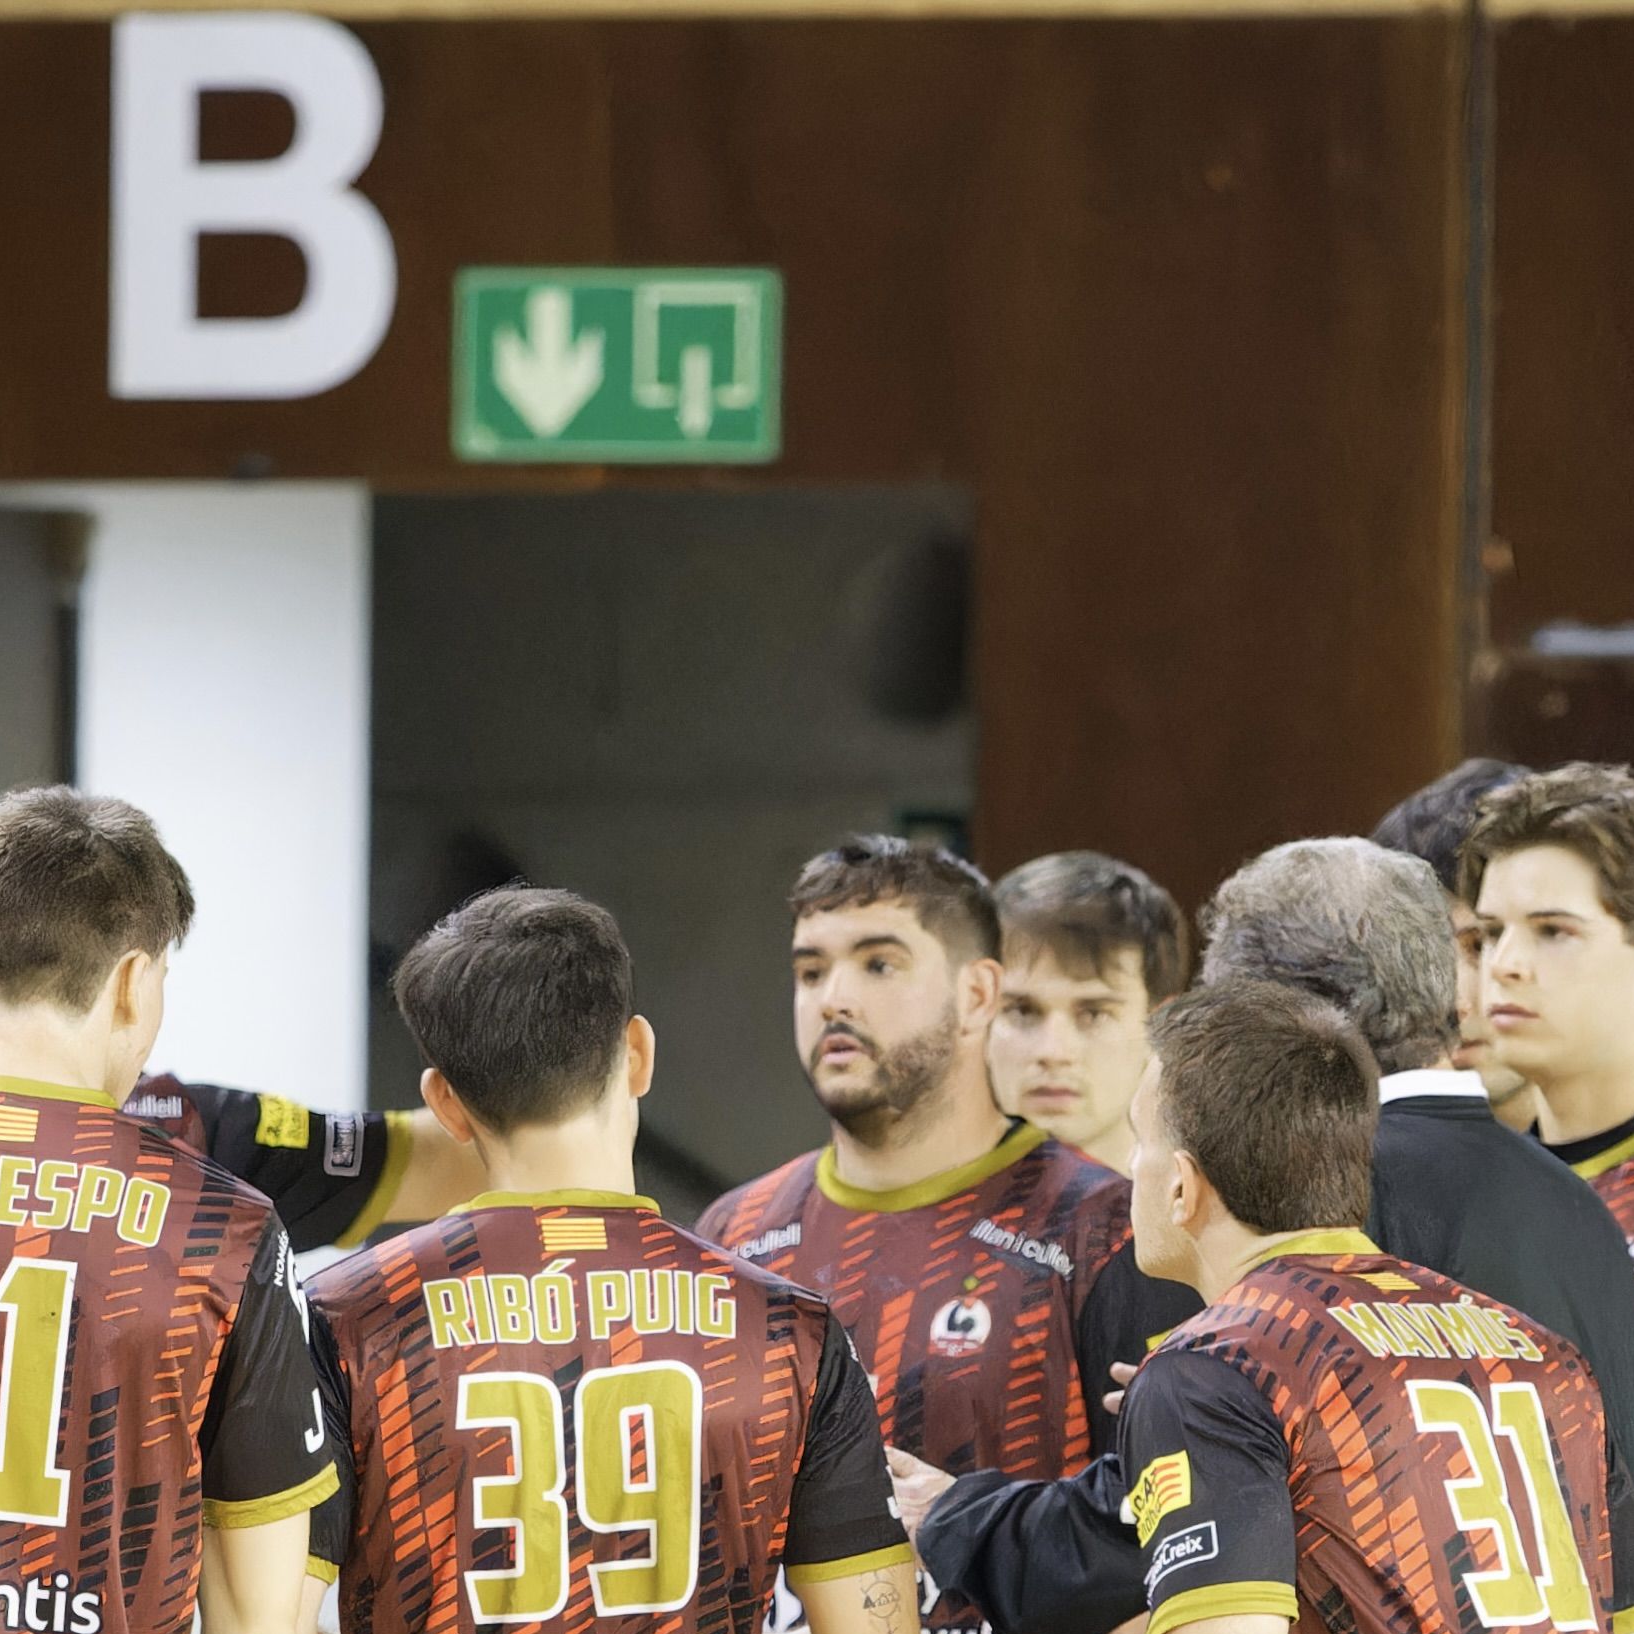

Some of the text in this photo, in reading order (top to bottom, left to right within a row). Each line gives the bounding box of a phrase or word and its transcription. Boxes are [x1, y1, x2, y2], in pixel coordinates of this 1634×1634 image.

[109, 11, 397, 400] B
[422, 1257, 738, 1349] RIBÓ PUIG
[1327, 1294, 1544, 1362] MAYMÚS
[453, 1360, 704, 1627] 39
[1405, 1379, 1599, 1632] 31
